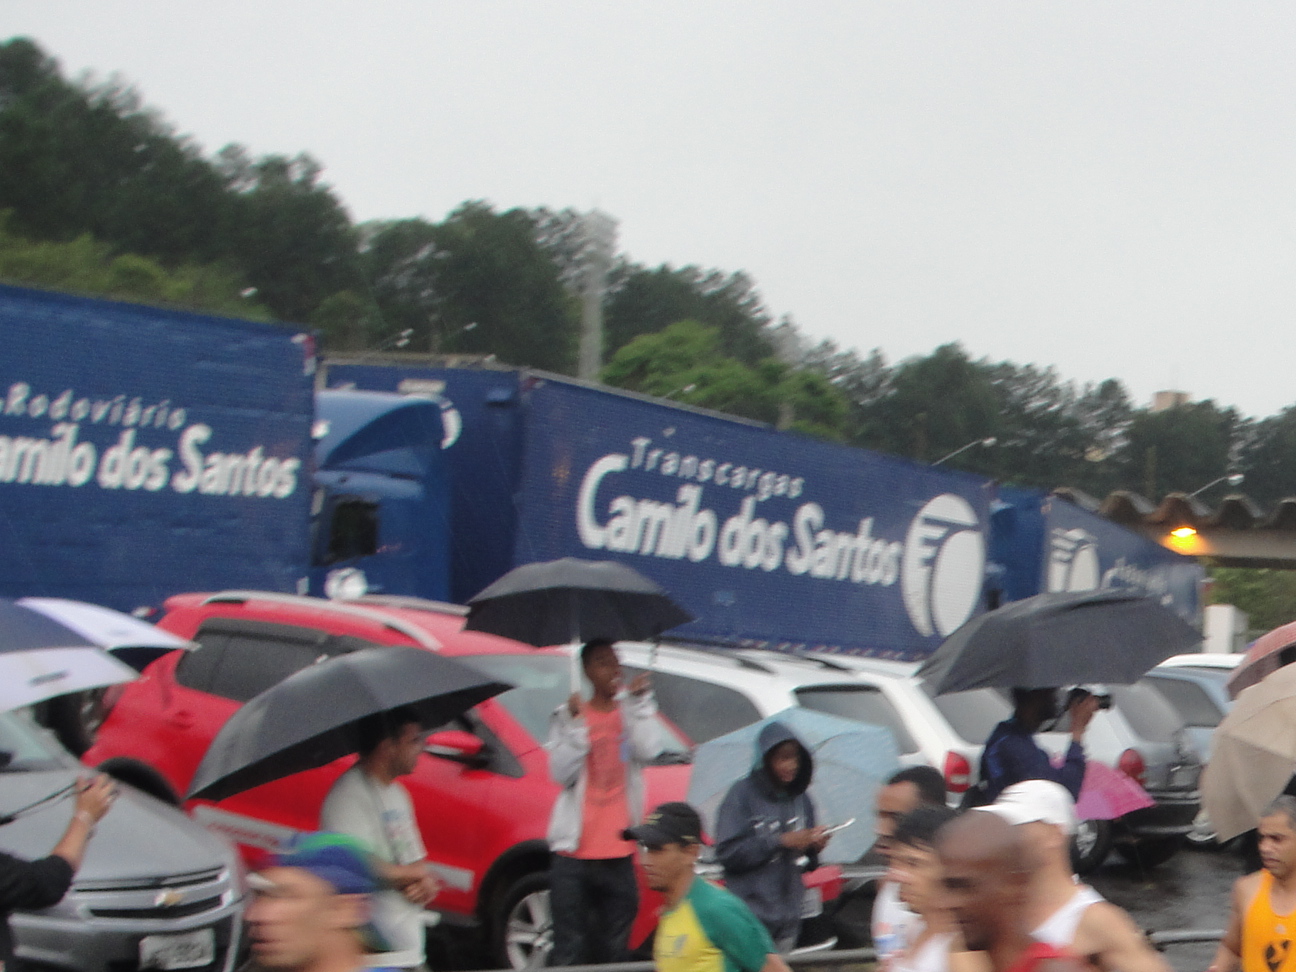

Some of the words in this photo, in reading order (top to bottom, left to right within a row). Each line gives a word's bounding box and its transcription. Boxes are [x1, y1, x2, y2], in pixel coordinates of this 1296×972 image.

[0, 422, 97, 487] milo
[97, 428, 173, 492] dos
[172, 423, 302, 499] Santos
[631, 436, 806, 501] Transcargas
[576, 453, 718, 563] Camilo
[718, 496, 790, 572] dos
[786, 502, 902, 587] Santos
